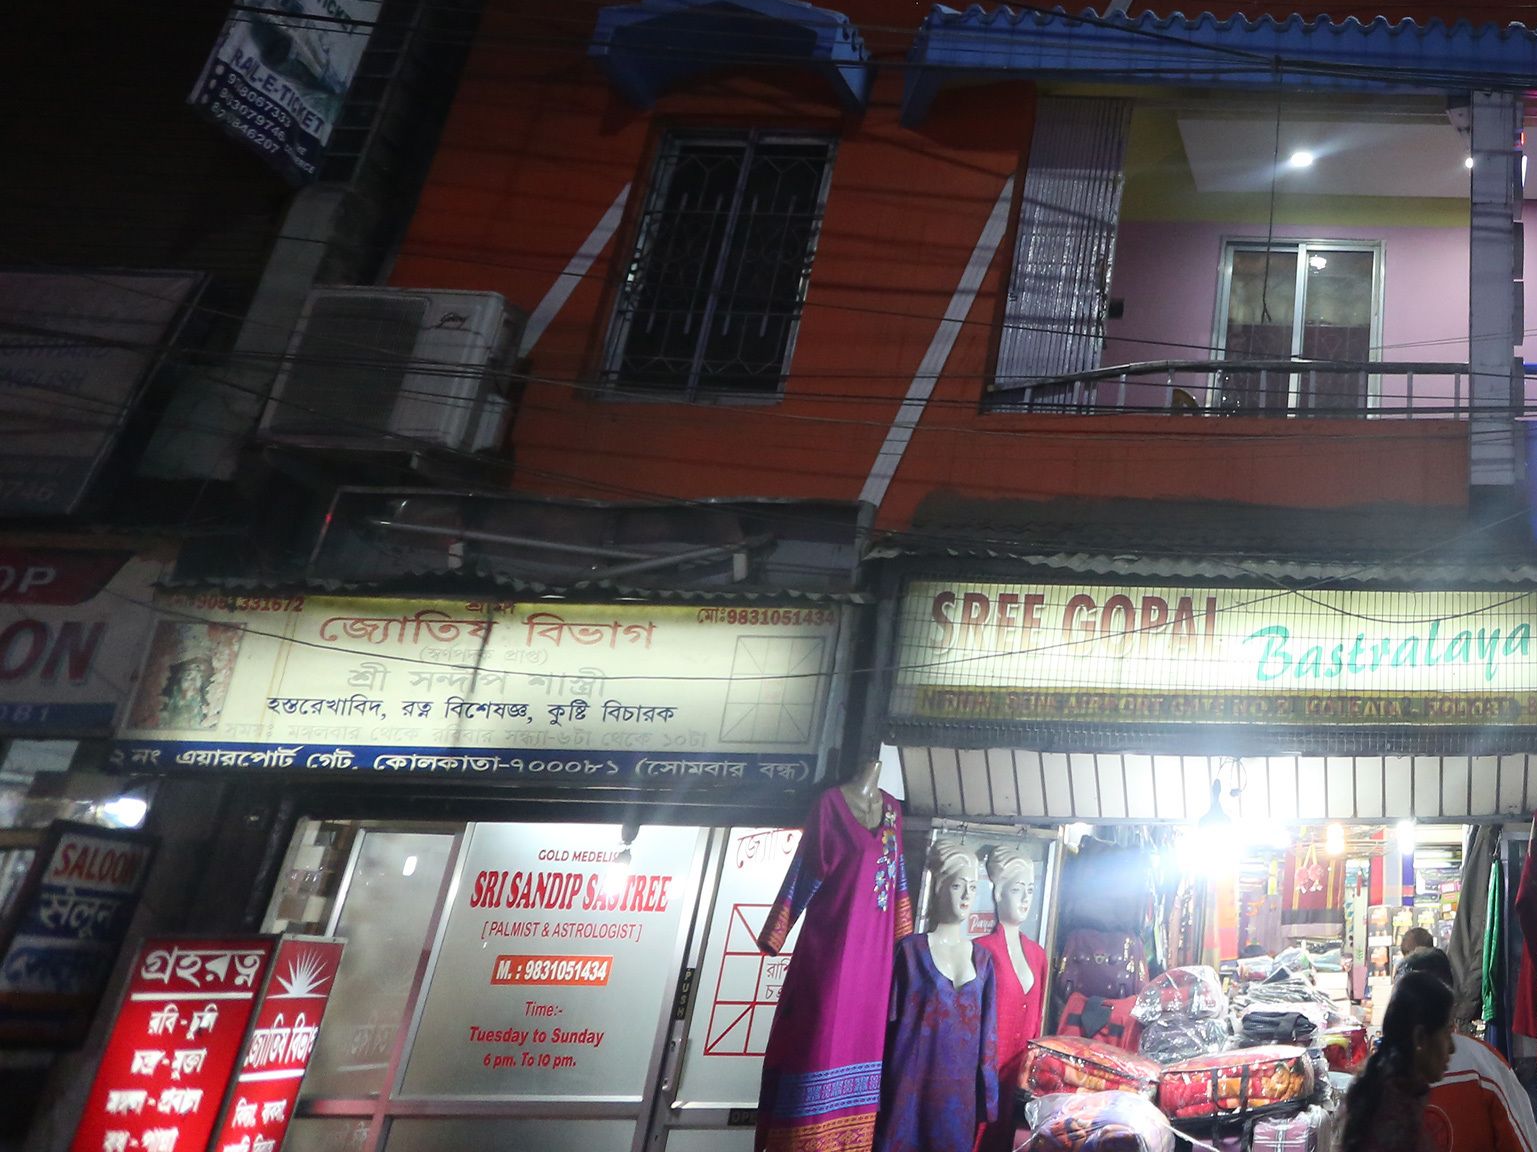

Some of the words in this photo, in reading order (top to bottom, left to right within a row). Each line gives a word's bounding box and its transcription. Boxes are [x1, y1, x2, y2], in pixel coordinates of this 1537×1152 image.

[319, 609, 500, 645] জ্যোতিষ
[521, 612, 656, 649] বিভাগ
[931, 591, 1046, 655] SREE
[1242, 619, 1532, 682] Bastralaya
[266, 694, 387, 722] হস্তরেখাবিদ,
[601, 699, 679, 724] বিচারক
[175, 744, 306, 769] এয়ারপোর্ট
[538, 849, 570, 863] GOLD
[571, 850, 622, 864] MEDELIS
[470, 870, 509, 909] SRI
[507, 871, 584, 911] SANDIP
[541, 923, 551, 938] &
[141, 945, 266, 989] গ্রহরত্ন
[523, 960, 609, 982] 9831051434
[469, 1026, 529, 1047] Tuesday
[532, 1028, 547, 1044] to
[550, 1028, 605, 1048] Sunday
[483, 1053, 492, 1066] 6
[493, 1055, 517, 1070] pm.
[521, 1052, 535, 1067] To
[552, 1056, 577, 1071] pm.
